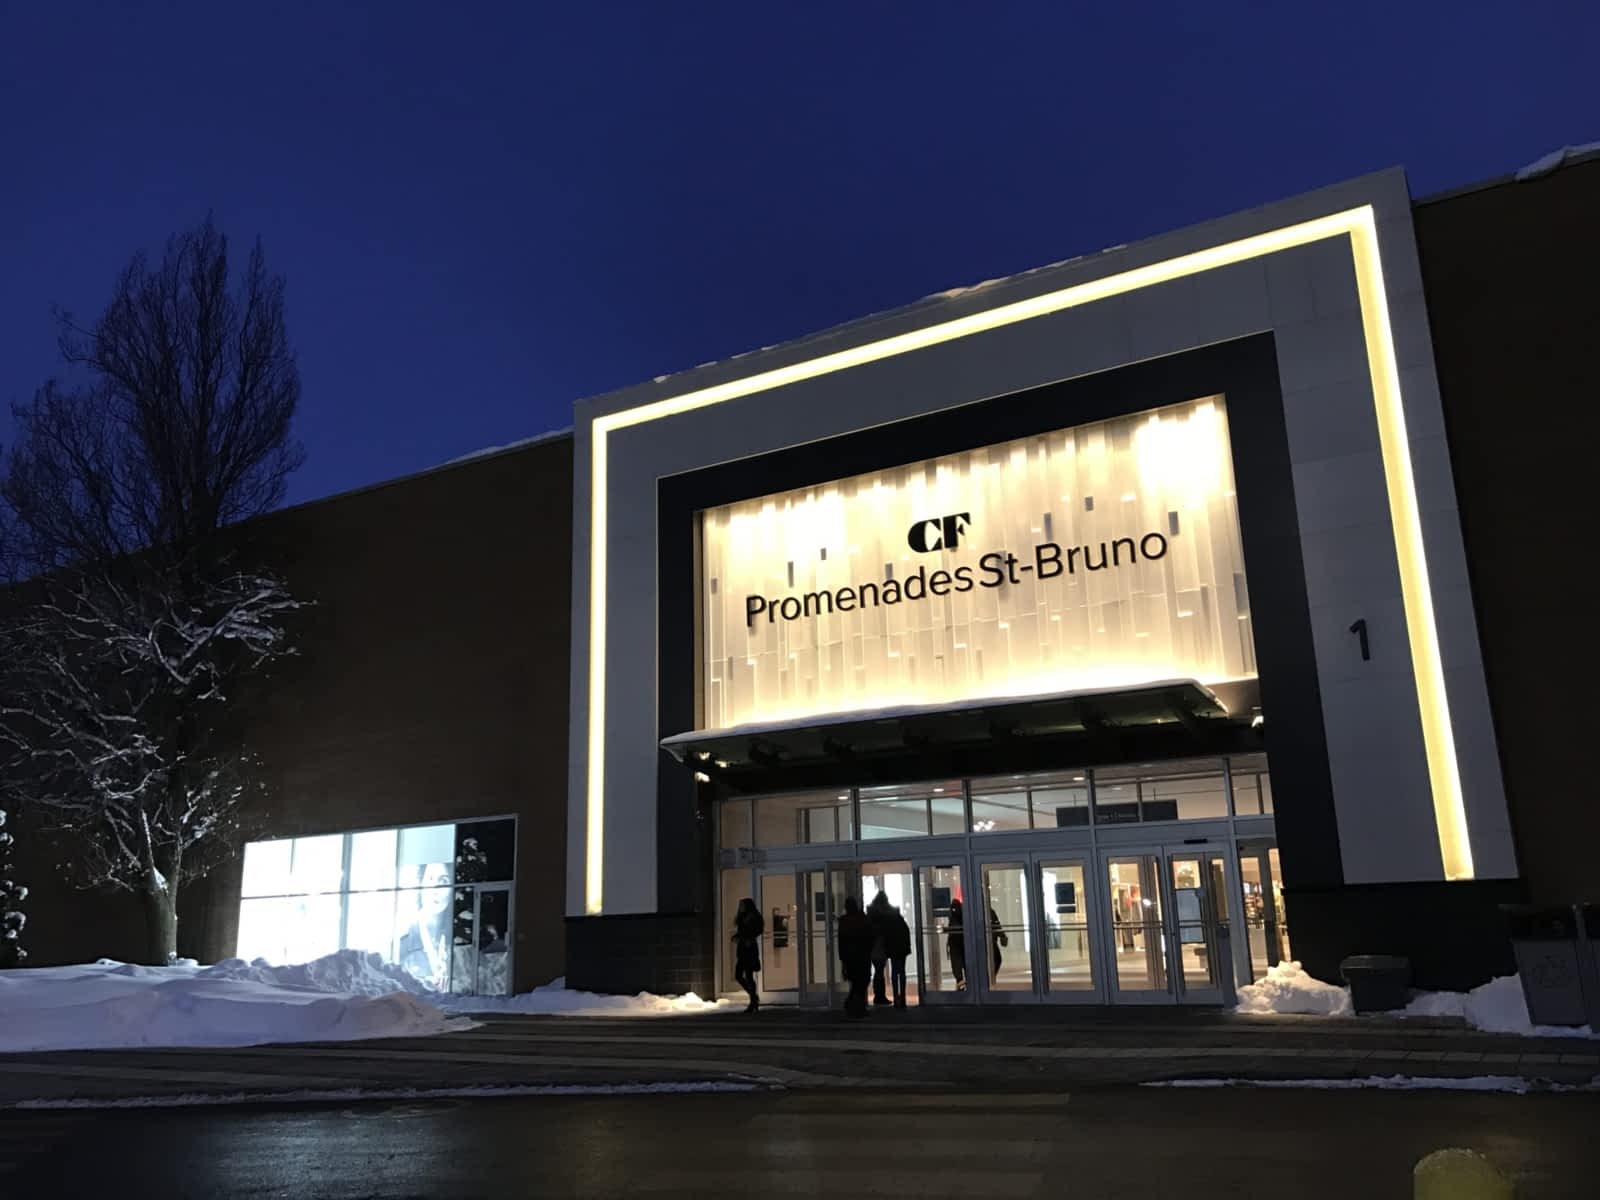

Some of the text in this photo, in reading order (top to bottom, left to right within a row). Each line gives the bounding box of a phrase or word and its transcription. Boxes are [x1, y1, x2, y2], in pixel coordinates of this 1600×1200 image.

[907, 512, 970, 553] CF
[746, 532, 1167, 627] Promenades St-Bruno
[1350, 618, 1370, 661] 1
